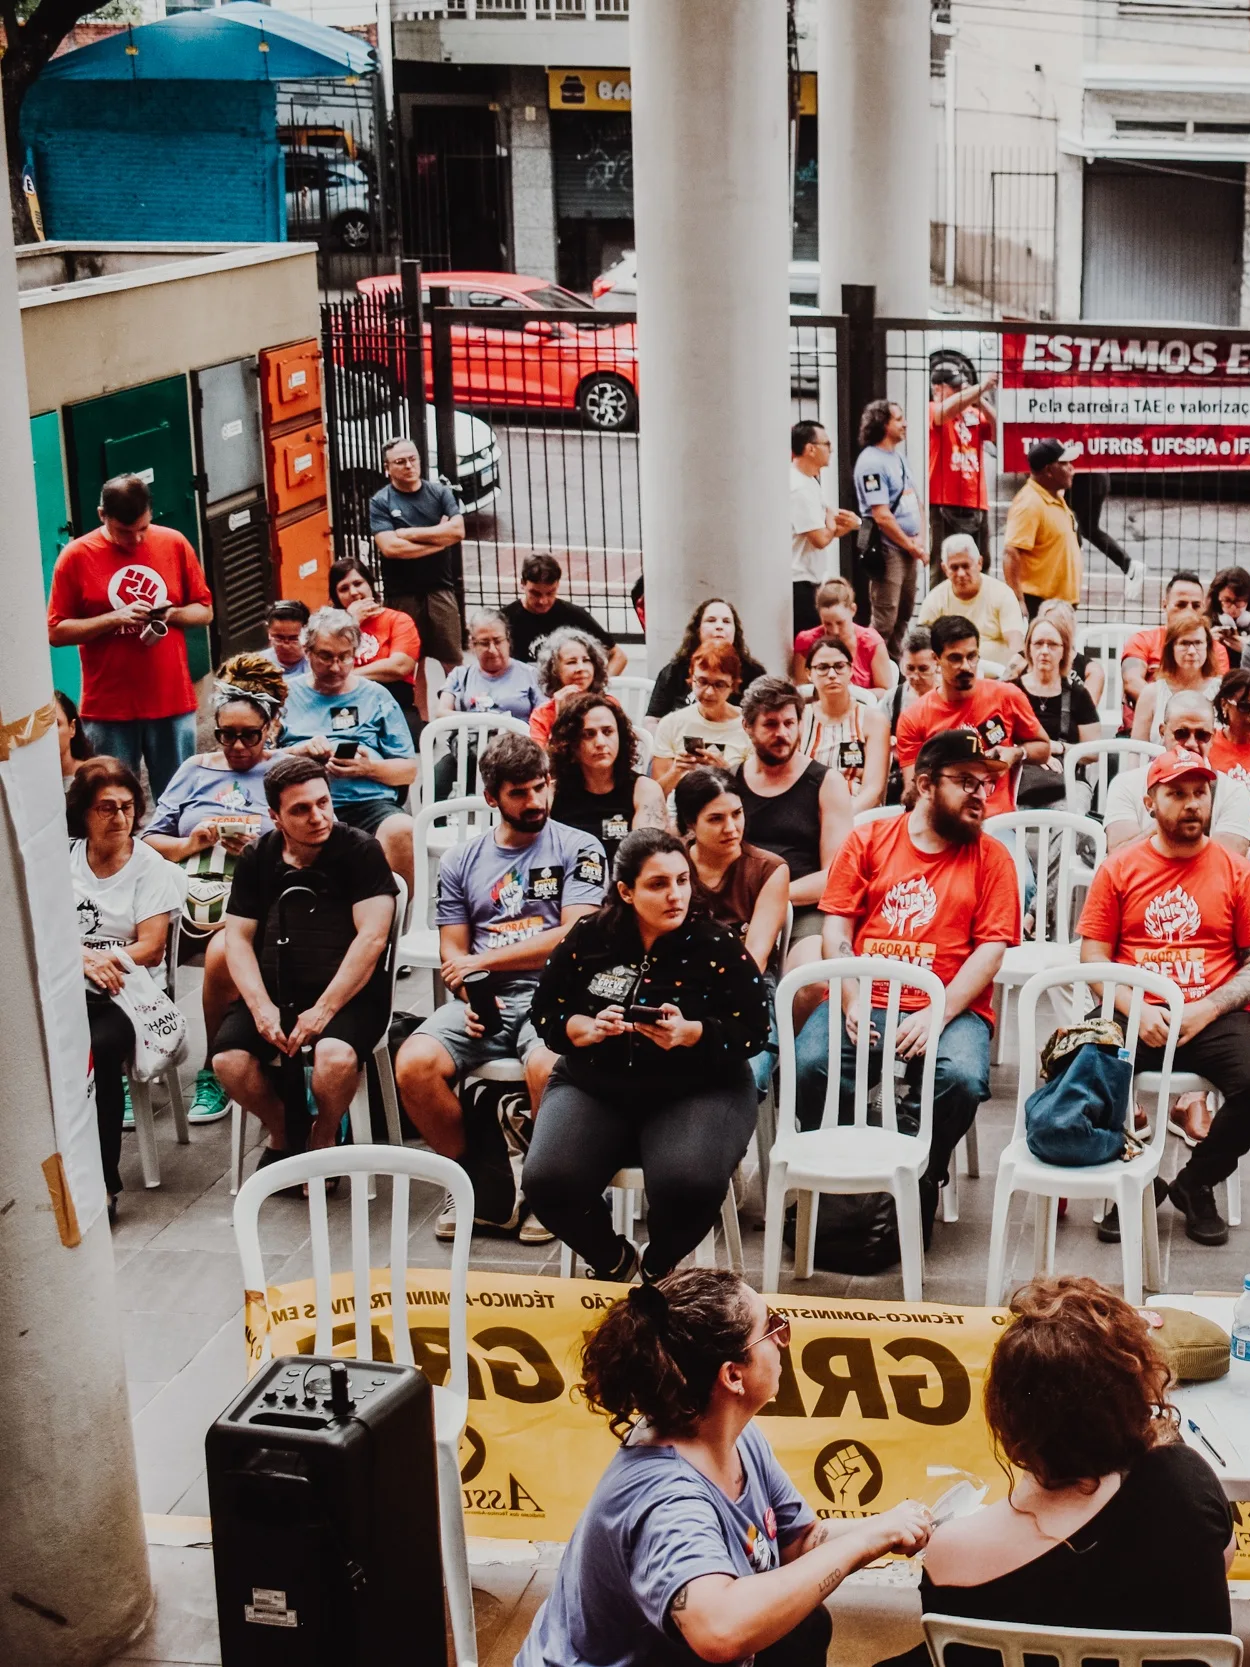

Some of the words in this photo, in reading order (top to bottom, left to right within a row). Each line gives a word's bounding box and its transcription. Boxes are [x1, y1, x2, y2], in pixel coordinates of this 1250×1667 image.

[598, 80, 631, 100] BA
[1022, 334, 1218, 375] ESTAMOS
[1029, 398, 1062, 413] Pela
[1067, 398, 1129, 413] carreira
[1135, 399, 1162, 414] TAE
[1166, 402, 1176, 413] e
[1087, 437, 1149, 457] UFRGS,
[1152, 437, 1218, 455] UFCSPA
[871, 942, 911, 956] AGORA
[1143, 950, 1186, 962] AGORA
[155, 1021, 178, 1038] YOU
